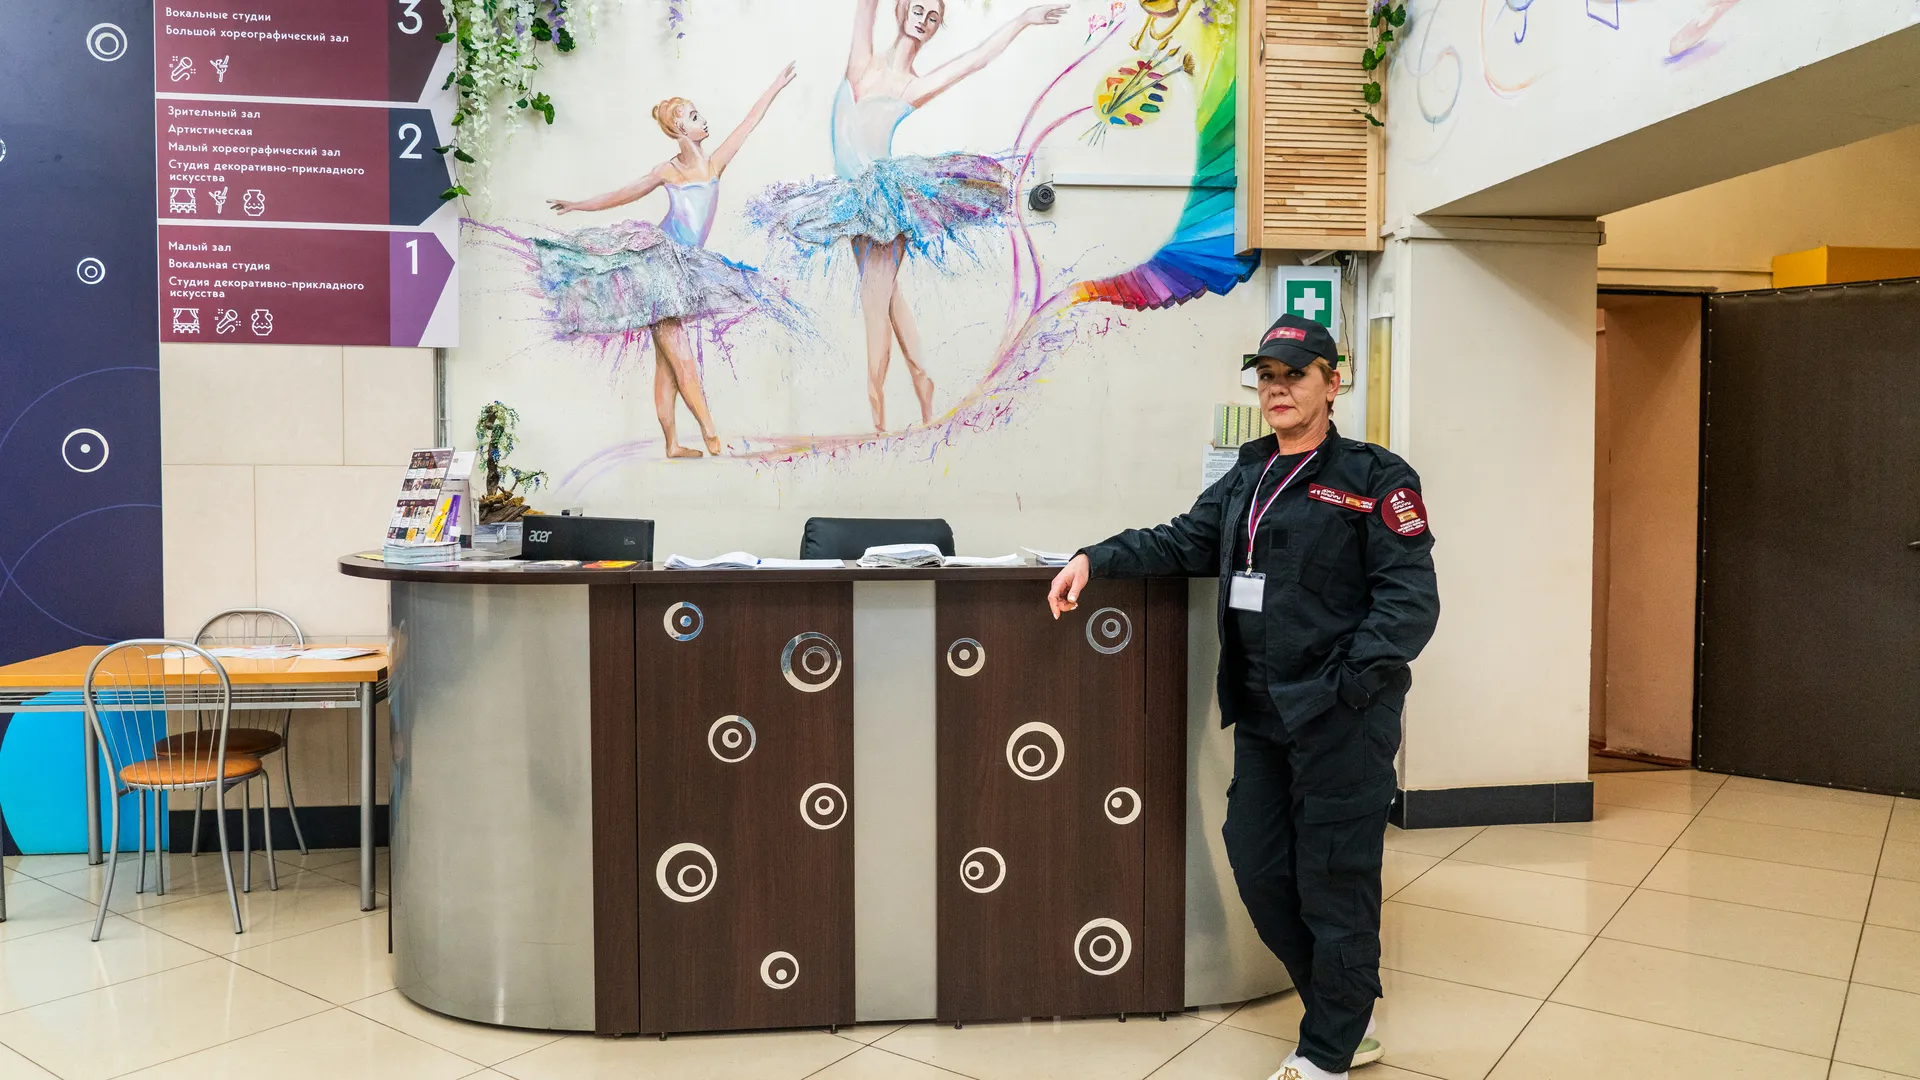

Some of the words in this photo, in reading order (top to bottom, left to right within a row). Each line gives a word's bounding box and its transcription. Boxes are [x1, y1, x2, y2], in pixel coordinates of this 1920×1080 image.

[165, 7, 228, 20] Вокальные
[232, 12, 271, 23] студии
[397, 0, 423, 35] 3
[165, 24, 216, 37] Большой
[220, 29, 326, 42] хореографический
[330, 35, 349, 43] зал
[167, 106, 237, 118] Зрительный
[241, 111, 261, 119] зал
[167, 124, 253, 136] Артистическая
[398, 122, 423, 160] 2
[168, 141, 208, 152] Малый
[212, 144, 318, 157] хореографический
[321, 149, 341, 157] зал
[168, 159, 210, 172] Студия
[213, 163, 365, 176] декоративно-прикладного
[169, 173, 225, 184] искусства
[168, 240, 208, 251] Малый
[212, 244, 232, 252] зал
[405, 238, 418, 275] 1
[168, 258, 228, 270] Вокальная
[231, 262, 271, 273] студия
[168, 276, 210, 288] Студия
[213, 279, 365, 291] декоративно-прикладного
[169, 290, 225, 300] искусства
[528, 530, 552, 543] acer
